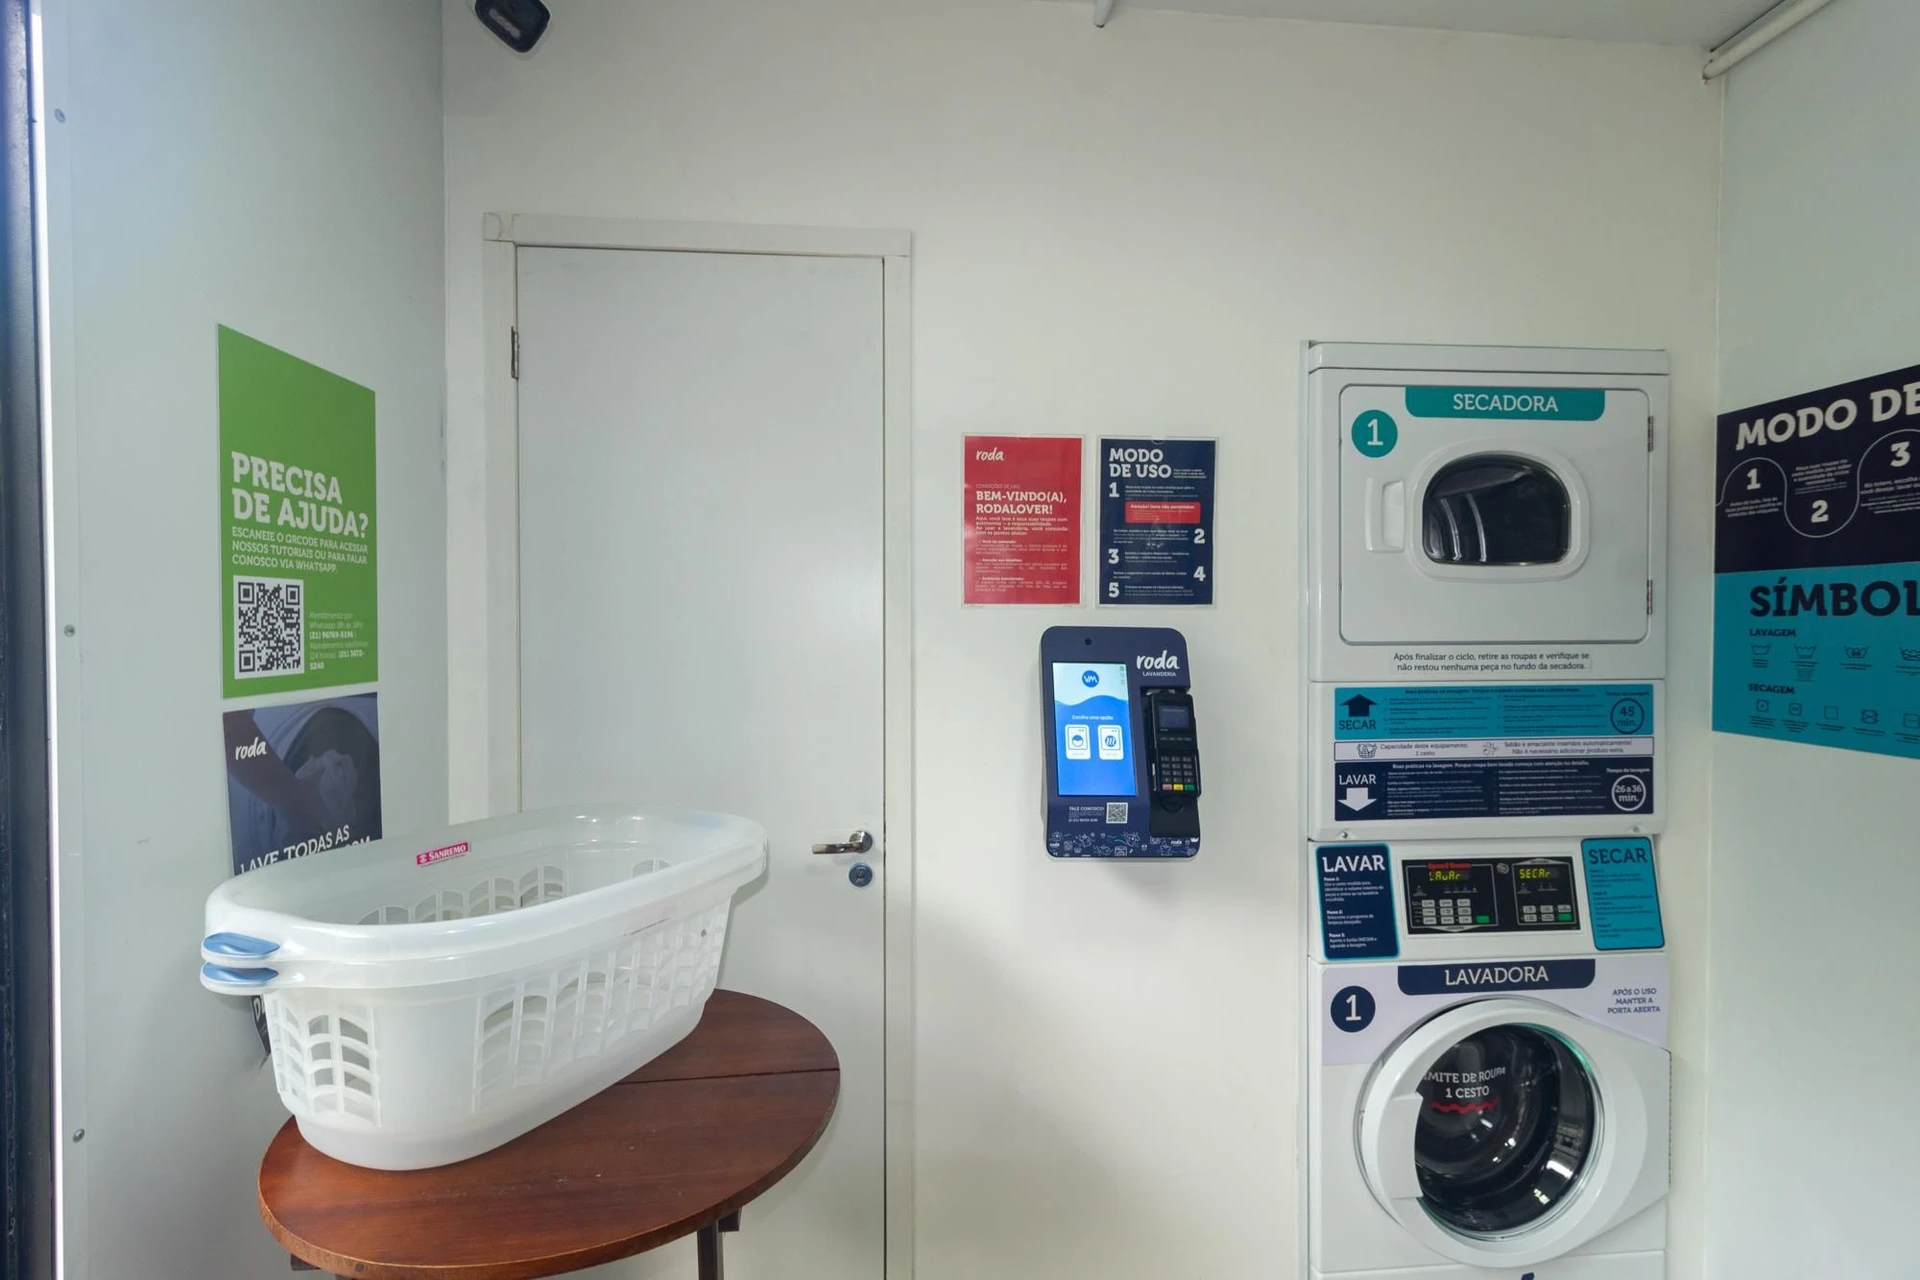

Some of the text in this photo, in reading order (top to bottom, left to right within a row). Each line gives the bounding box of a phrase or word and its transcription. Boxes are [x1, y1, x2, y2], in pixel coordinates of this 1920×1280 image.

[1453, 394, 1558, 412] SECADORA
[1736, 381, 1920, 450] MODO DE
[1367, 418, 1384, 446] 1
[976, 447, 1004, 461] roda
[1109, 448, 1164, 462] MODO
[1890, 441, 1910, 467] 3
[231, 451, 342, 504] PRECISA
[1110, 464, 1131, 478] DE
[1136, 464, 1172, 478] USO
[1747, 468, 1761, 490] 1
[976, 490, 1067, 503] BEM-VINDO(A),
[1110, 482, 1120, 498] 1
[231, 488, 369, 539] DE AJUDA?
[976, 504, 1052, 514] RODALOVER!
[1811, 500, 1829, 522] 2
[232, 526, 368, 553] ESCANEIE O QRCODE PARA ACESSAR
[1194, 528, 1205, 544] 2
[232, 541, 368, 564] NOSSOS TUTORIAIS OU PARA FALAR
[1108, 549, 1120, 564] 3
[232, 554, 278, 567] CONOSCO
[280, 558, 294, 568] VIA
[1194, 566, 1206, 581] 4
[1108, 582, 1120, 598] 5
[1750, 577, 1920, 616] SÍMBOL
[1749, 629, 1796, 637] LAVAGEM
[1136, 650, 1180, 670] roda
[1394, 653, 1413, 661] Após
[1456, 653, 1476, 661] ciclo,
[1546, 652, 1579, 661] verifique
[1748, 683, 1795, 694] SECAGEM
[1338, 720, 1376, 730] SECAR
[234, 737, 267, 760] roda
[1338, 774, 1376, 786] LAVAR
[1619, 793, 1639, 802] min.
[283, 834, 332, 860] TODAS
[335, 824, 350, 844] AS
[429, 844, 466, 860] SANREMO
[1588, 848, 1648, 864] SECAR
[1322, 855, 1385, 872] LAVAR
[1445, 966, 1548, 986] LAVADORA
[1613, 987, 1632, 995] APÓS
[1345, 994, 1362, 1021] 1
[1424, 1067, 1506, 1083] MITE DE ROUPA
[1446, 1086, 1489, 1098] 1 CESTO
